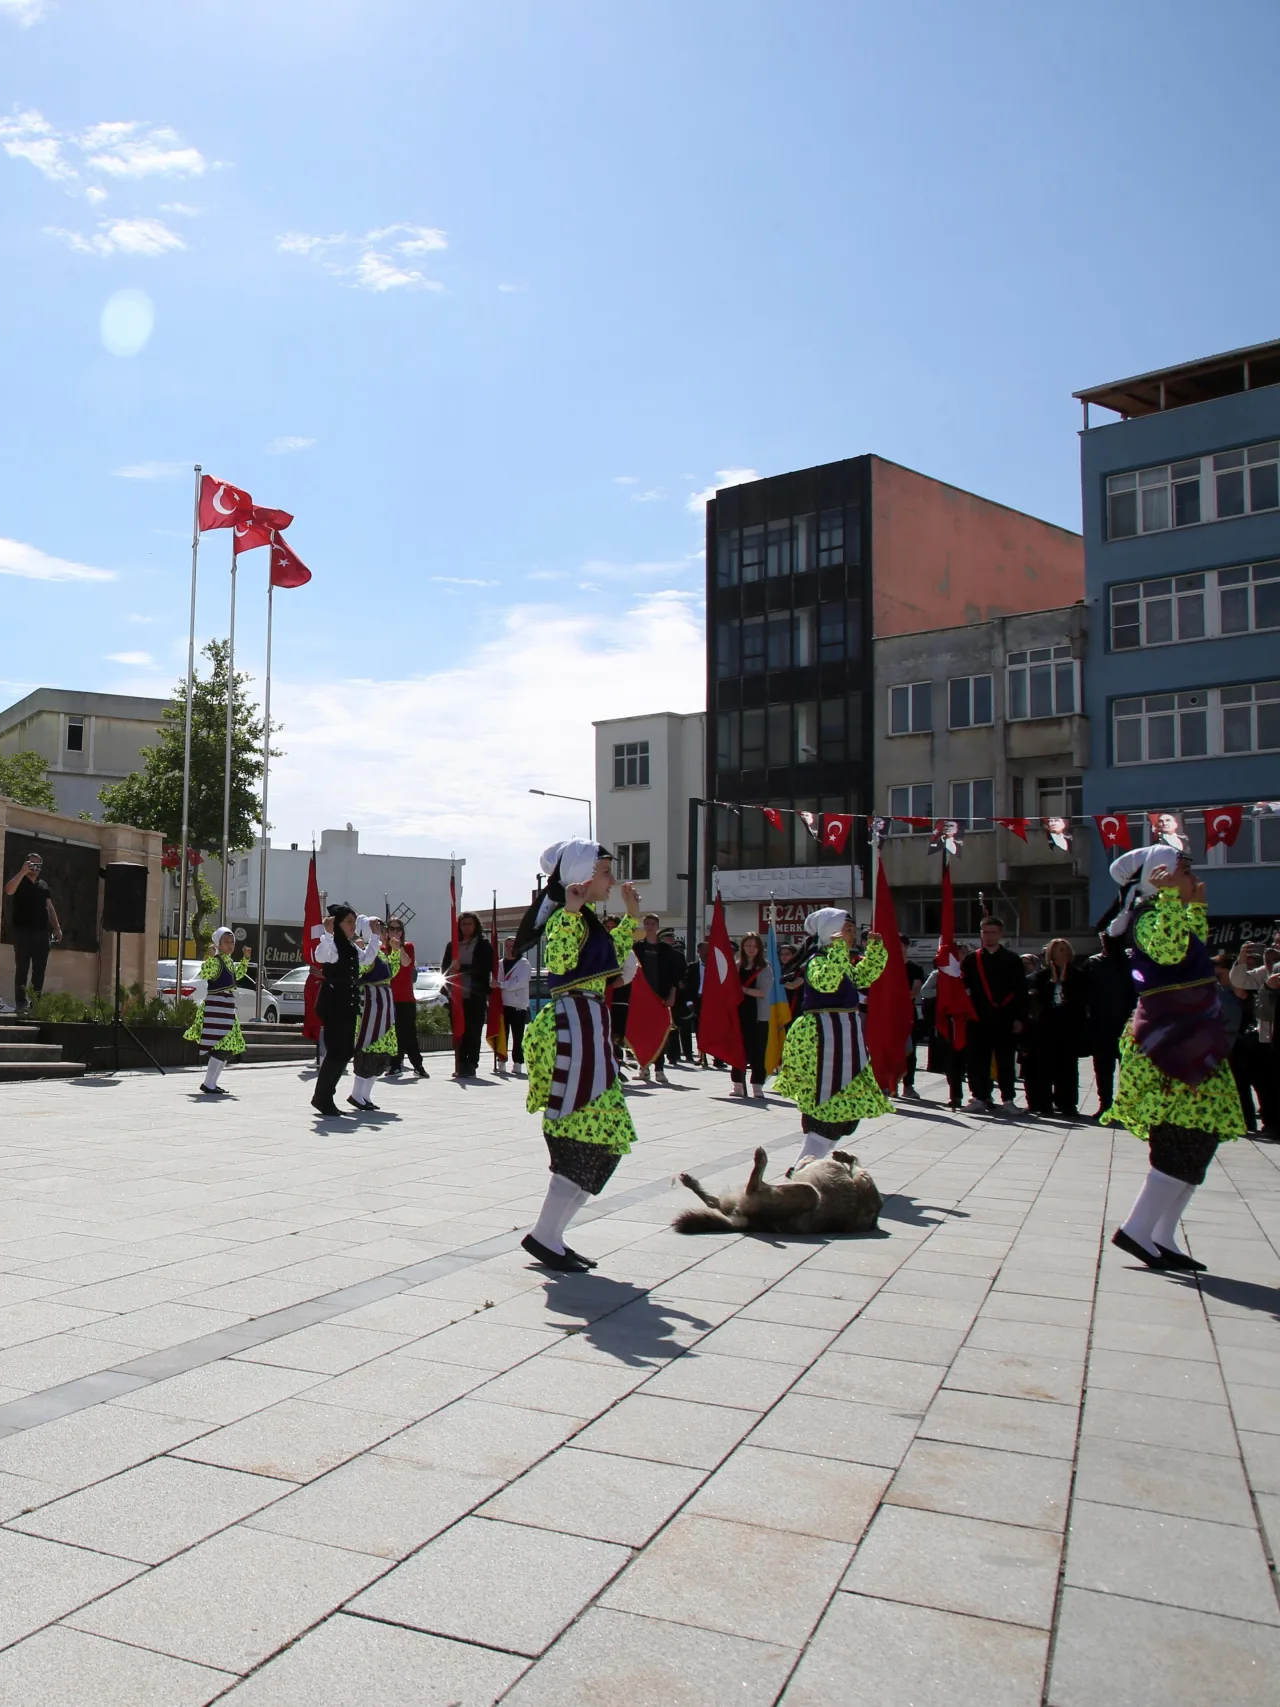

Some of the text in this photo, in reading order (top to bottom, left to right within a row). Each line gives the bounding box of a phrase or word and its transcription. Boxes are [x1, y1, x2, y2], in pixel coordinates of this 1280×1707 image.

[738, 868, 832, 882] MERKEZ
[776, 923, 805, 933] MERK
[265, 947, 303, 962] Ekmek
